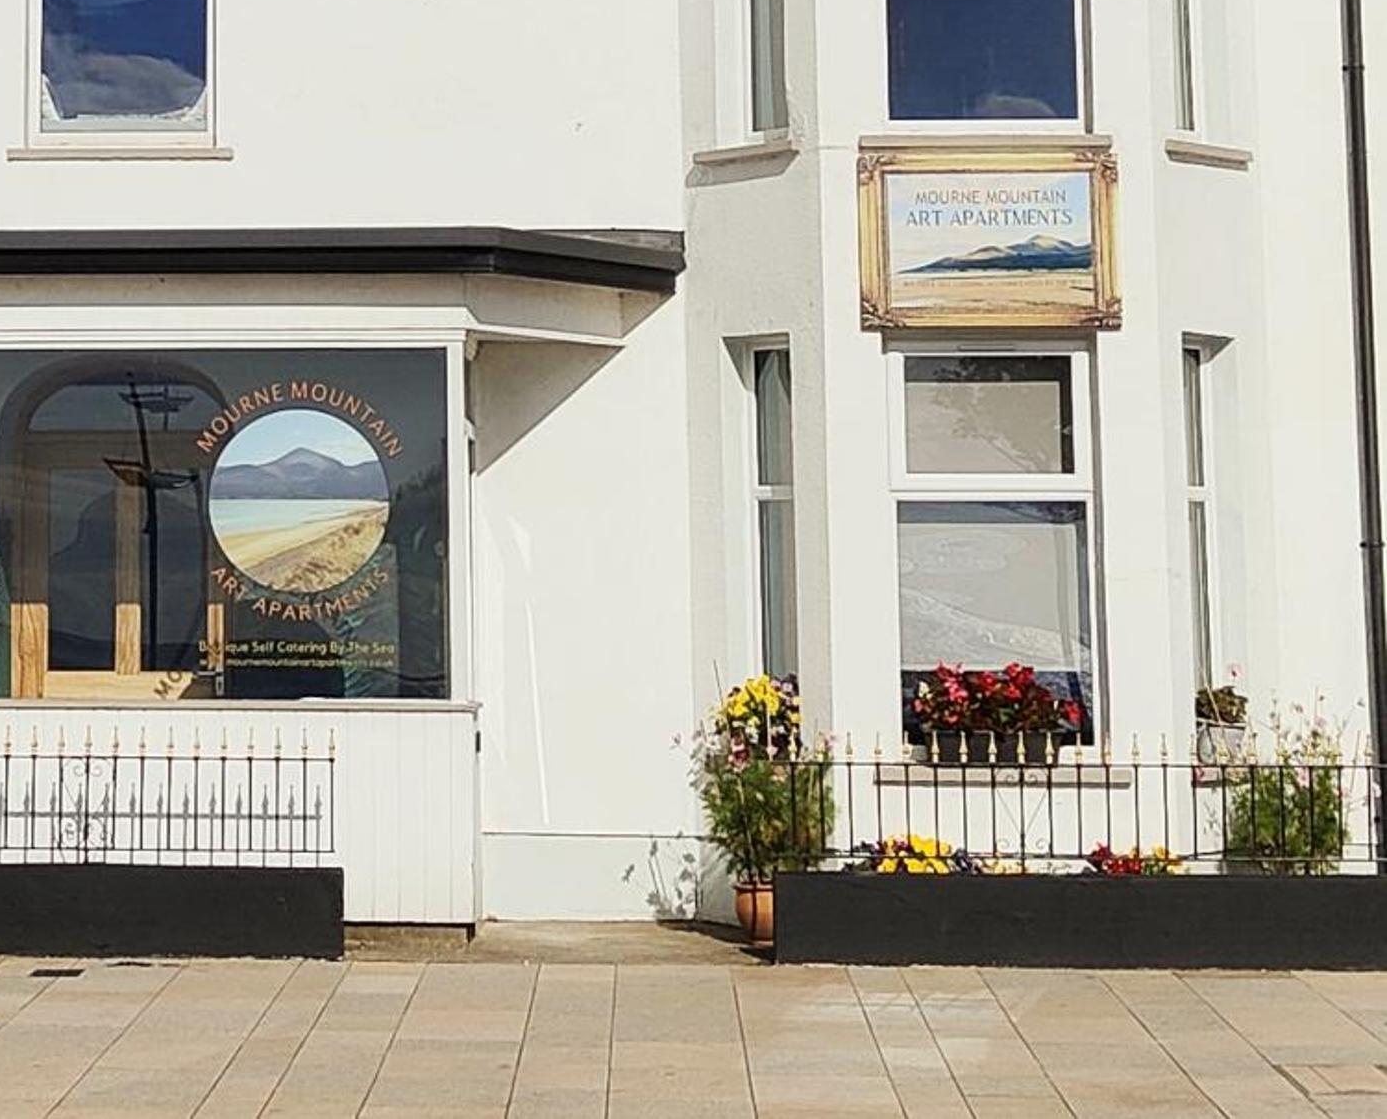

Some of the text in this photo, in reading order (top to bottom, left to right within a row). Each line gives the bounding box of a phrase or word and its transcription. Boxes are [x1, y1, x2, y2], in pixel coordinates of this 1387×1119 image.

[915, 189, 1067, 205] MOURNE MOUNTAIN
[906, 208, 1073, 226] ART APARTMENTS
[196, 381, 404, 458] MOURNE MOUNTAIN
[210, 567, 389, 621] ART APARTMENTS
[252, 641, 274, 654] Self
[277, 641, 327, 655] Catering
[372, 641, 395, 654] Sea
